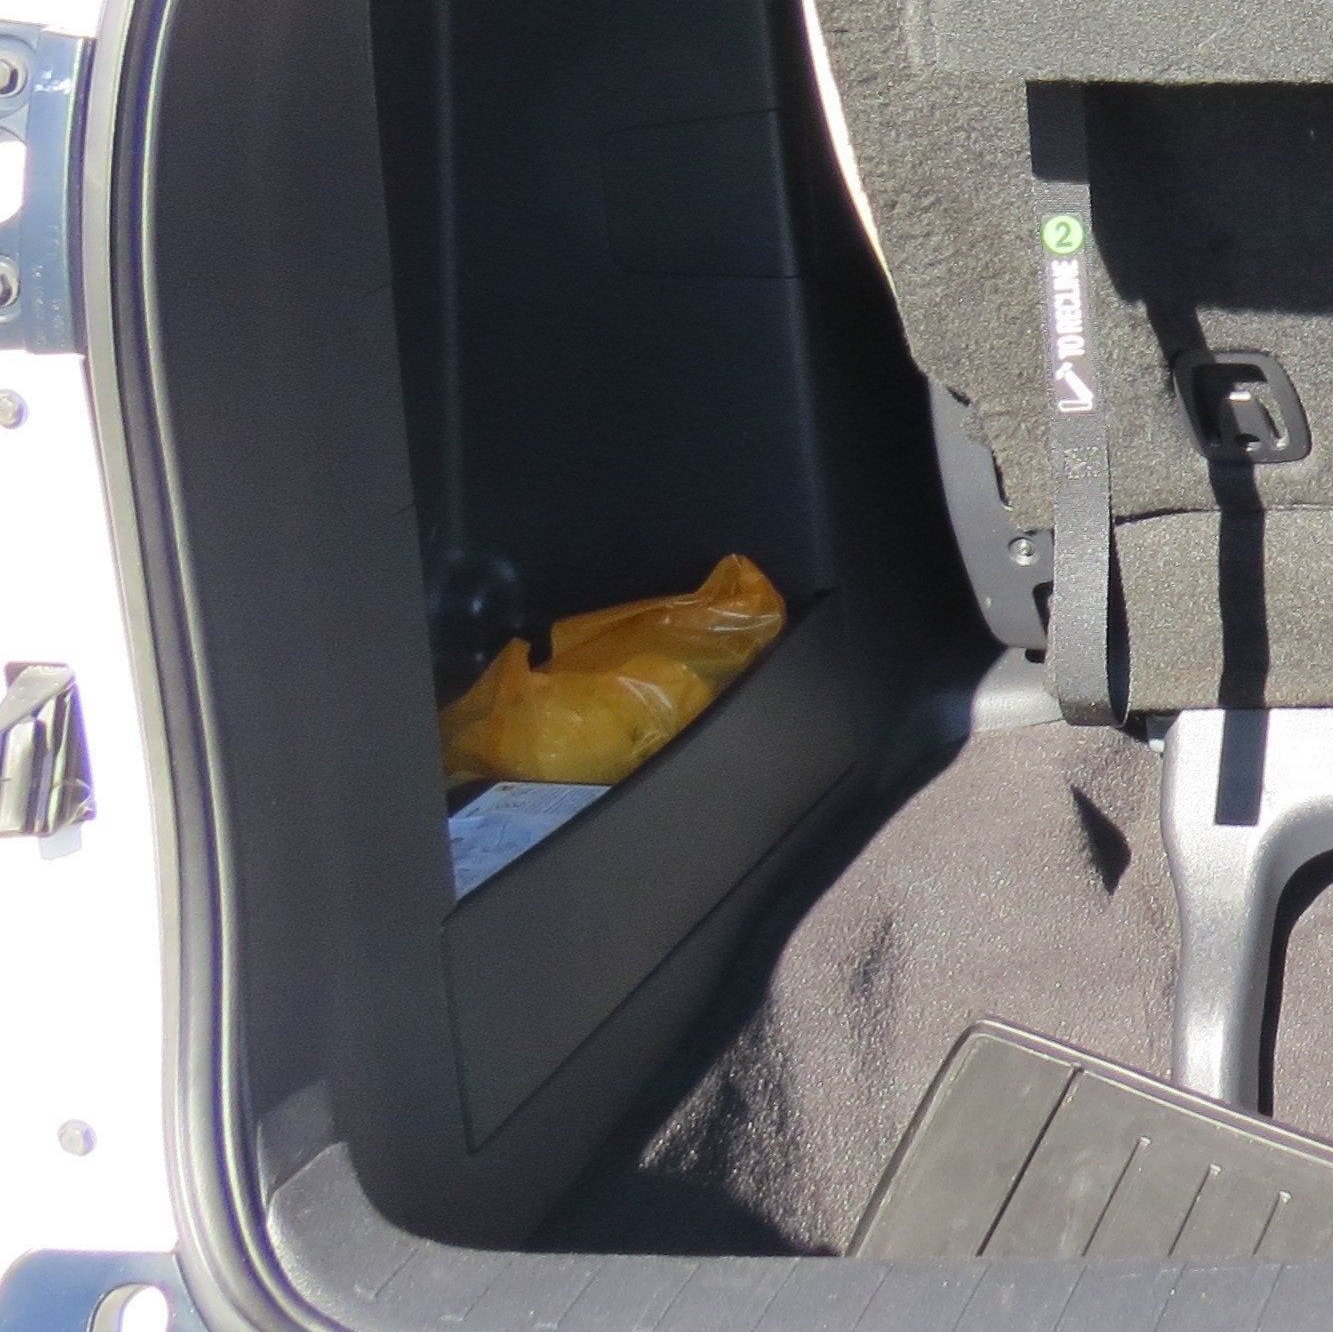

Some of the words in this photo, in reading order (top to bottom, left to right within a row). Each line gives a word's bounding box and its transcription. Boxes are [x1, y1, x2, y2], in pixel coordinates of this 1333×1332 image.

[1055, 221, 1073, 248] 2
[1051, 259, 1083, 334] RECLINE
[1056, 335, 1085, 360] TO
